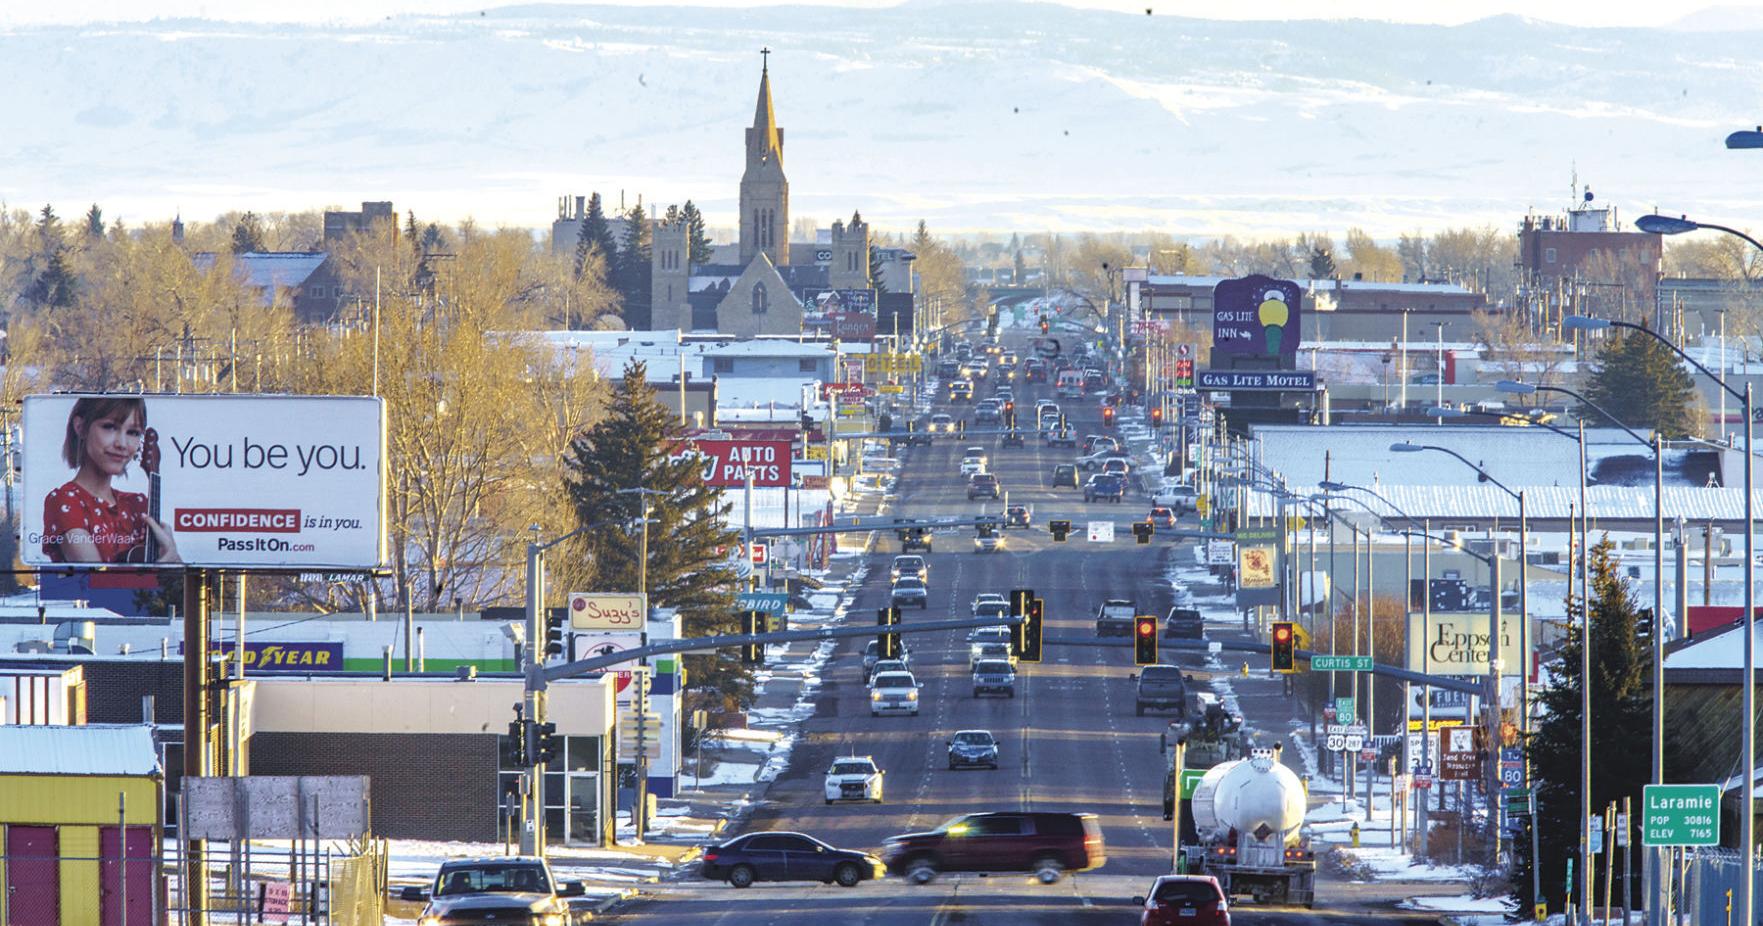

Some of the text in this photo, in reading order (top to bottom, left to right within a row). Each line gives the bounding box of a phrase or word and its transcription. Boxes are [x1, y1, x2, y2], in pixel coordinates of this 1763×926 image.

[1216, 312, 1254, 322] GAS LITE
[1218, 328, 1237, 338] INN
[867, 355, 921, 371] OTEL
[1203, 374, 1229, 386] GAS
[1232, 374, 1261, 386] LITE
[1266, 374, 1310, 386] MOTEL
[171, 437, 366, 476] You be you.
[729, 446, 775, 463] AUTO
[723, 464, 779, 481] PARTS
[179, 513, 363, 531] CONFIDENCE is in you.
[28, 533, 63, 545] Grace
[218, 537, 315, 552] PassItOn.com
[329, 573, 364, 581] LAMAR
[588, 601, 640, 624] Suzy's
[1315, 658, 1370, 668] CURTIS ST
[1329, 737, 1344, 748] 30
[1504, 770, 1521, 782] 80
[1650, 795, 1712, 809] Laramie
[1650, 816, 1712, 825] POP 30816
[1650, 829, 1712, 838] ELEV 7165
